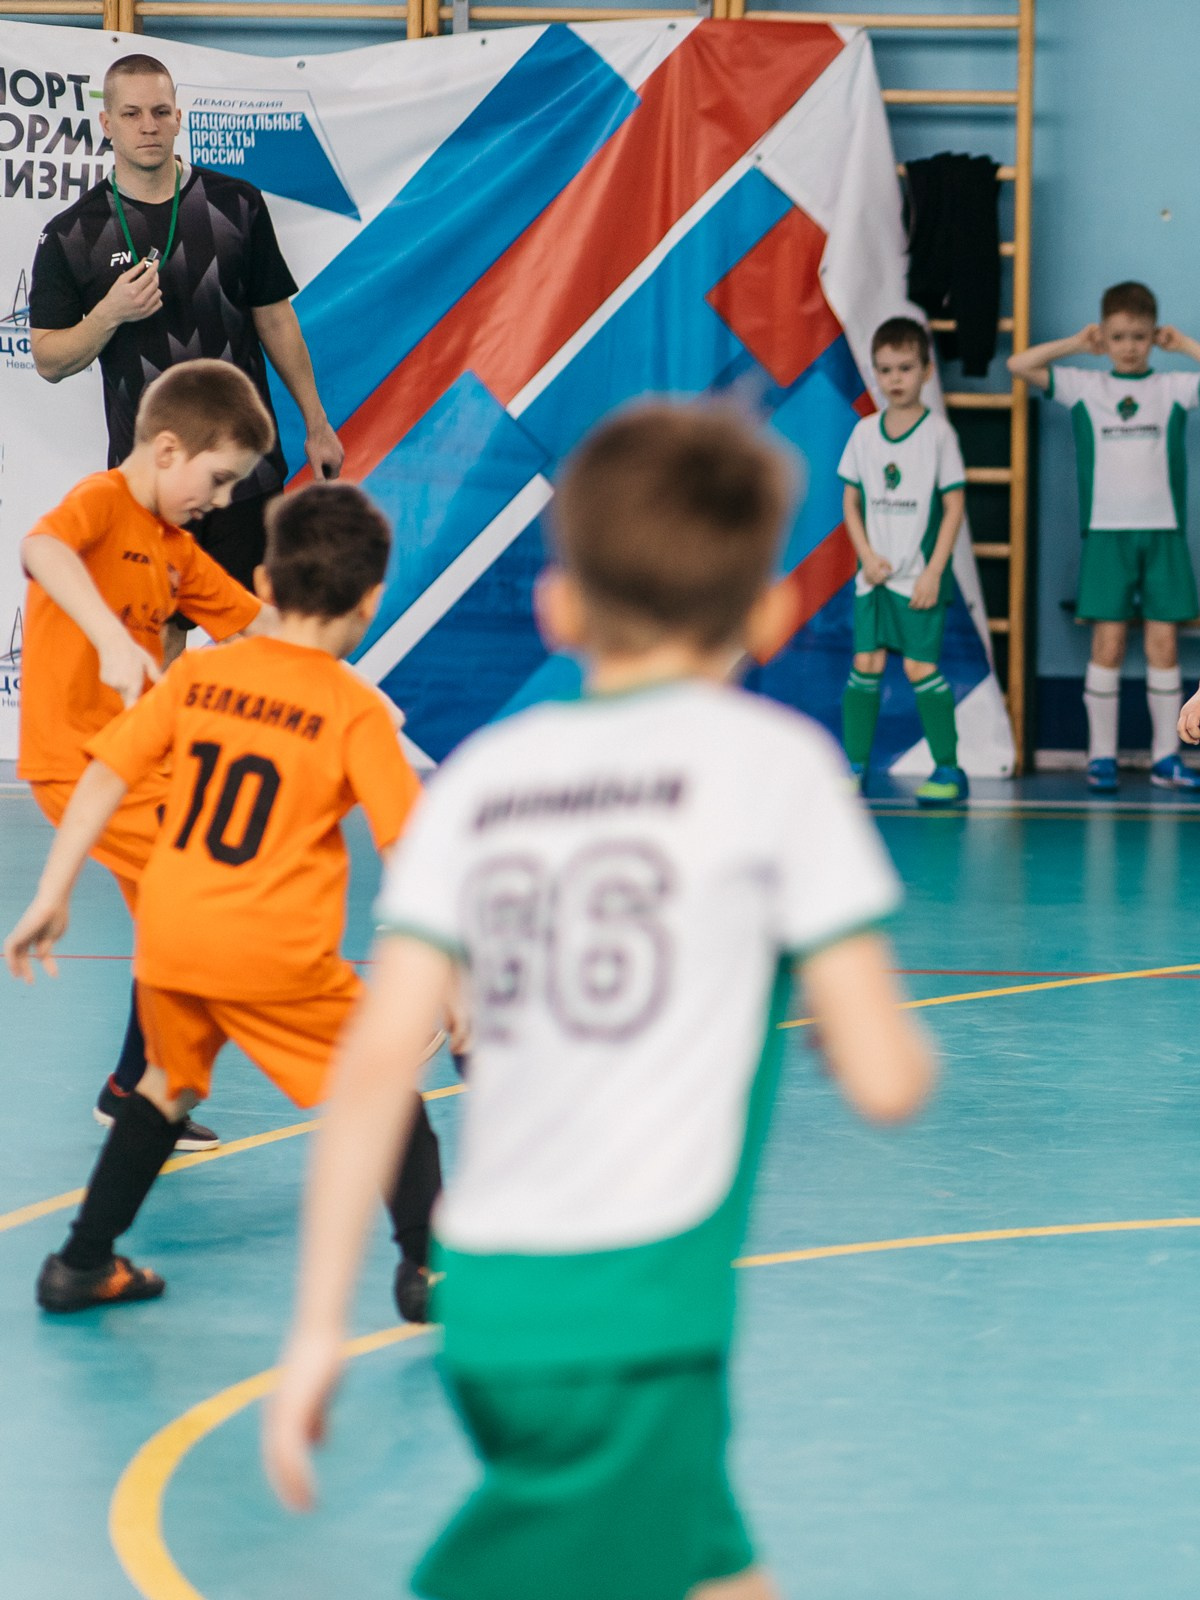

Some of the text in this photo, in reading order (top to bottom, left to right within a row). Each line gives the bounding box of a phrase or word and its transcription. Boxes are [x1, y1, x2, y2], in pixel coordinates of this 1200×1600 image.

[0, 67, 104, 111] ОРТ-
[192, 97, 283, 109] ДЕМОГРАФИЯ
[190, 112, 304, 131] НАЦИОНАЛЬНЫЕ
[191, 130, 255, 148] ПРОЕКТЫ
[192, 147, 245, 165] РОССИИ
[0, 158, 104, 201] ИЗН
[174, 741, 281, 867] 10
